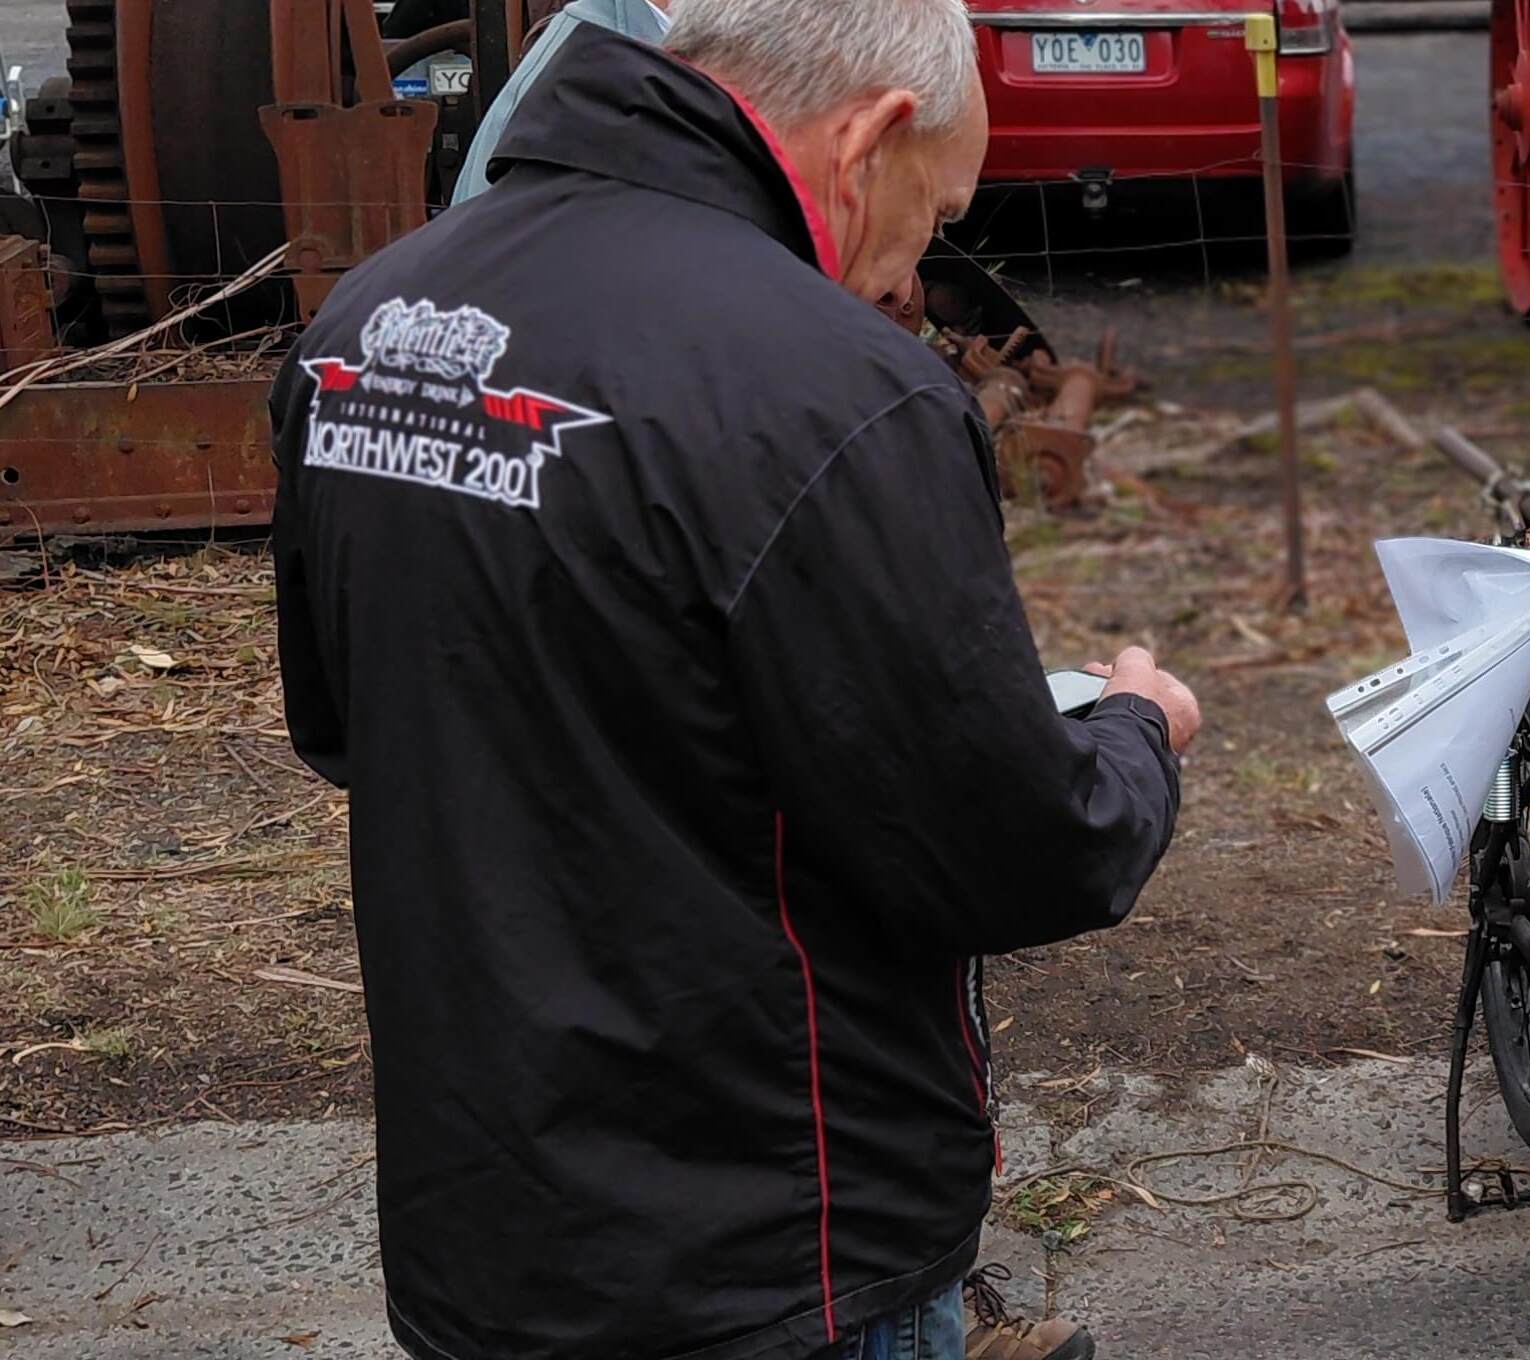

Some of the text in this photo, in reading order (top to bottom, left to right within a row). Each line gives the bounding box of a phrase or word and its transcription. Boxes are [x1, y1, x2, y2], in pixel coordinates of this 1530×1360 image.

[1035, 37, 1141, 64] YOE 030
[308, 420, 528, 499] NORTHWEST 200
